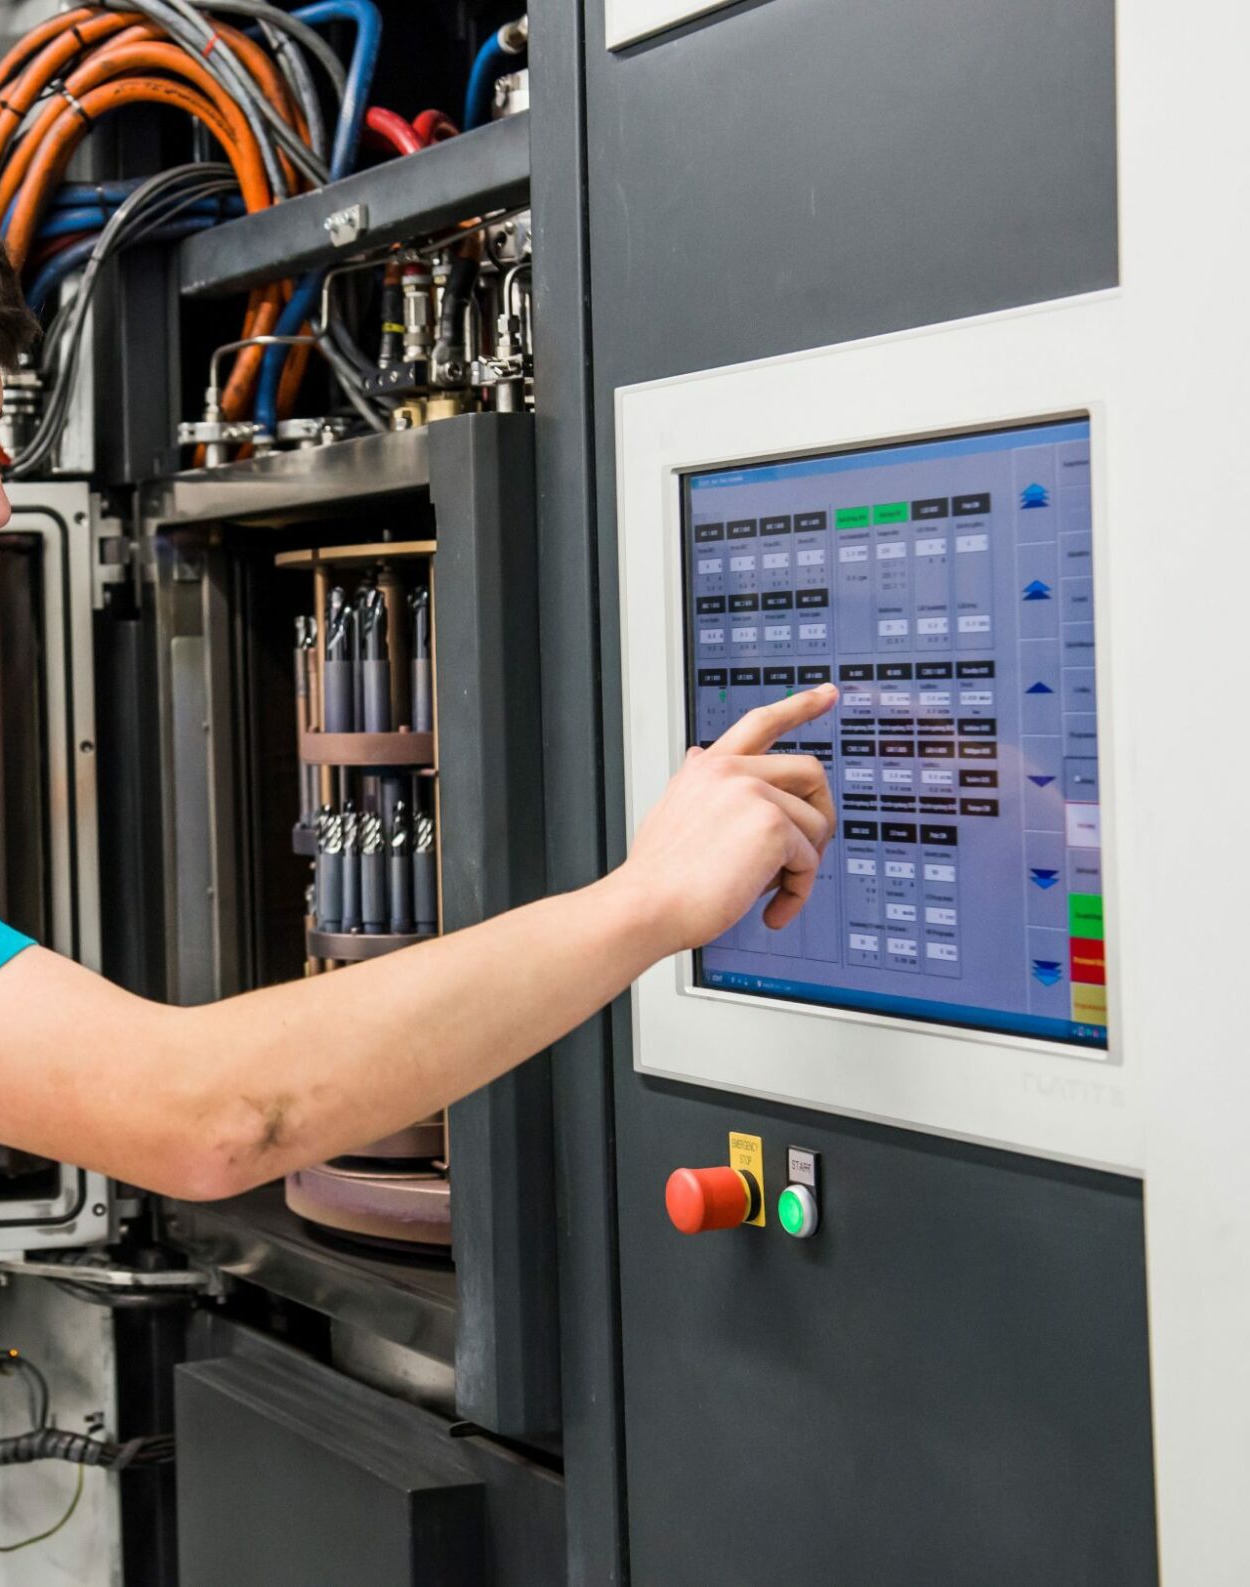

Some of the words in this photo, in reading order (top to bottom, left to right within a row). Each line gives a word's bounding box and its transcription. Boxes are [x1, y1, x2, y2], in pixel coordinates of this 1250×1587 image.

[731, 1138, 759, 1152] EMERGENCY
[740, 1154, 752, 1166] STOP
[791, 1159, 812, 1173] START
